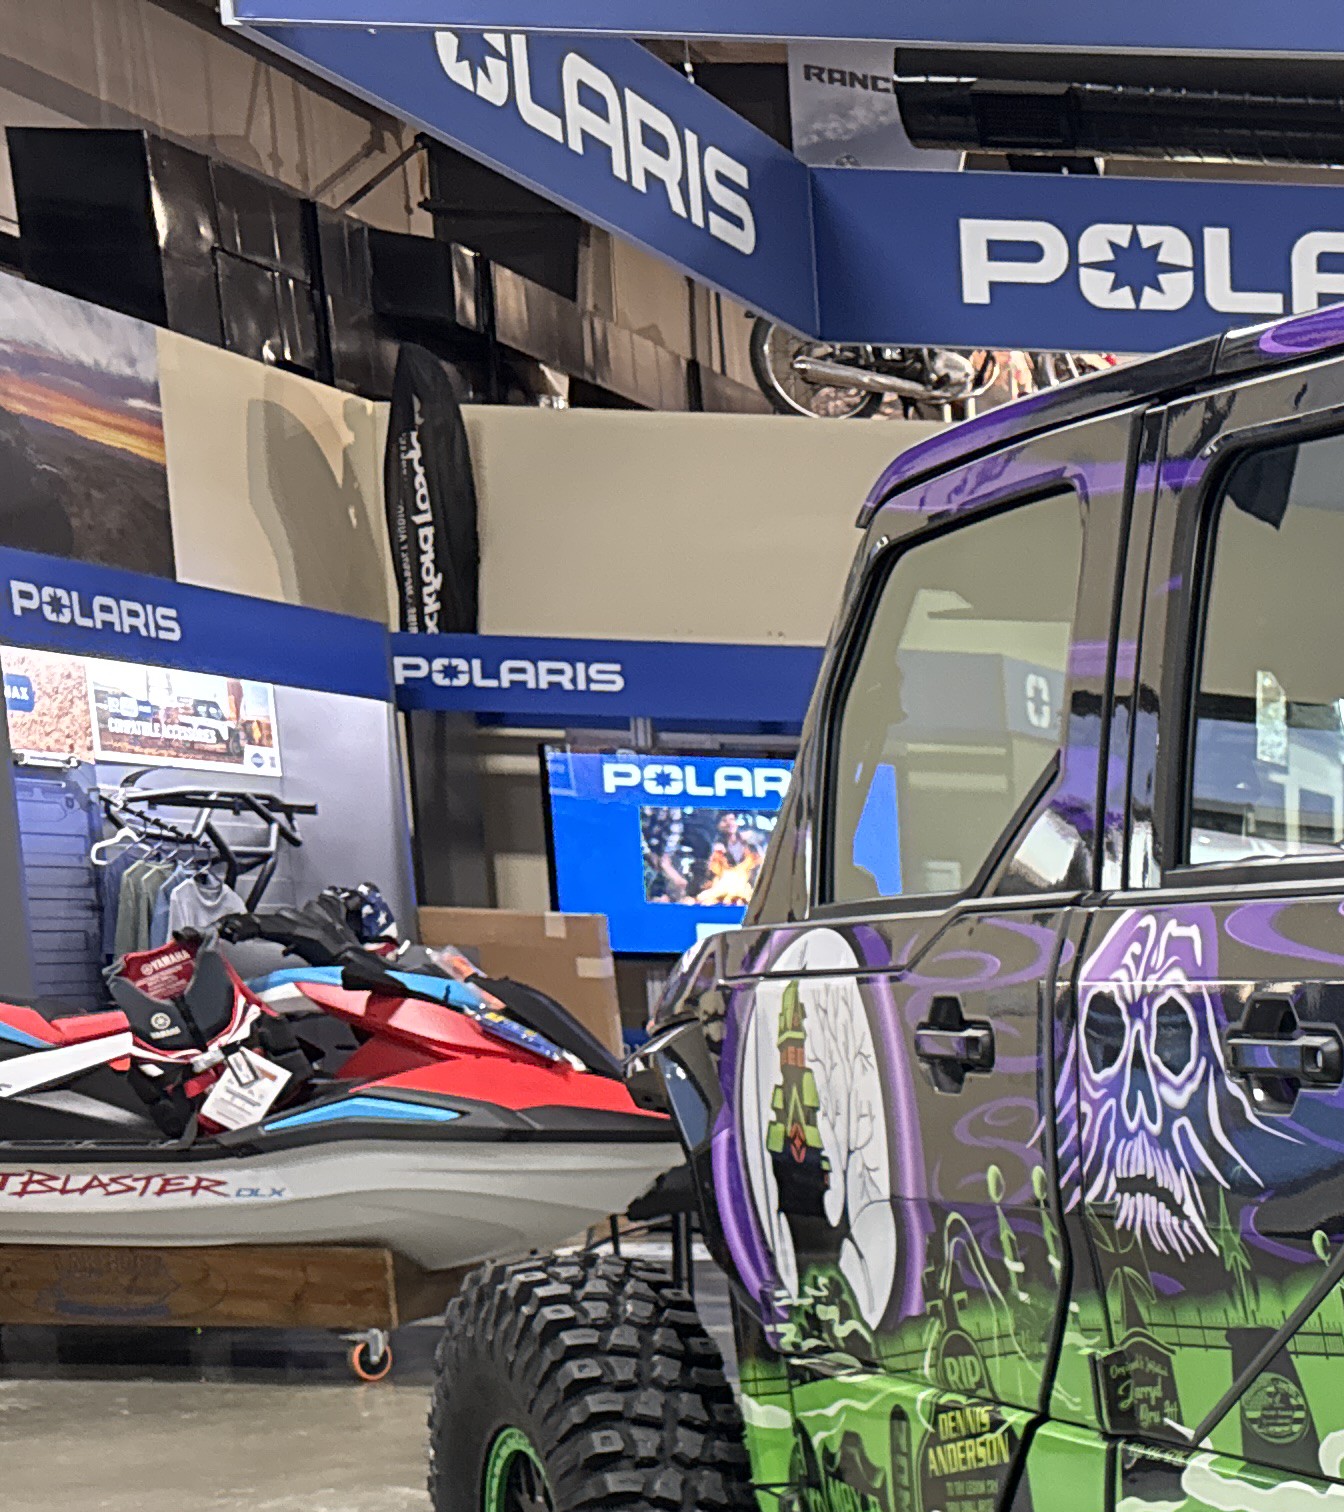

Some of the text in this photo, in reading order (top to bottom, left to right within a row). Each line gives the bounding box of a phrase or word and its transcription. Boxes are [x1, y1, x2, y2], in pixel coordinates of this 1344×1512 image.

[803, 64, 897, 93] RANC
[10, 581, 182, 642] POLARIS
[394, 656, 625, 693] POLARIS
[943, 1355, 981, 1390] RIP
[938, 1406, 995, 1440] DENNIS
[928, 1433, 1010, 1478] ANDERSON
